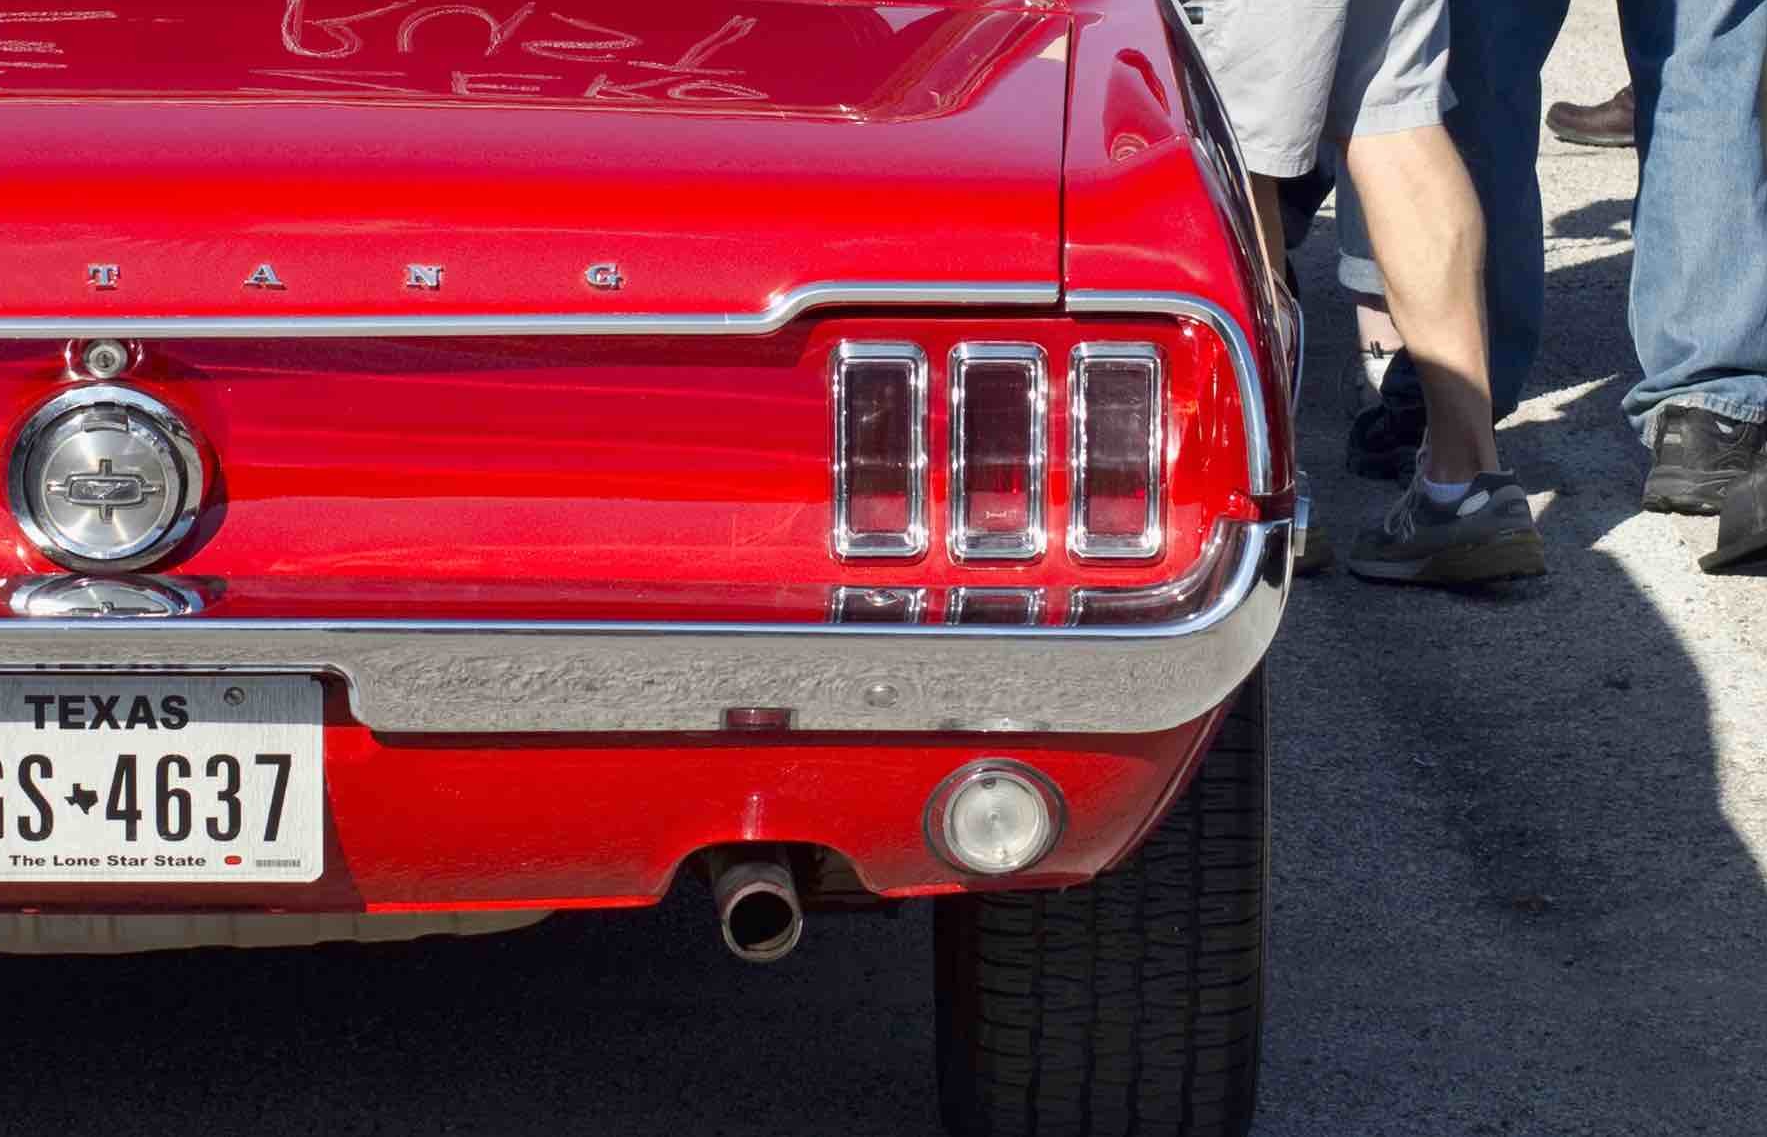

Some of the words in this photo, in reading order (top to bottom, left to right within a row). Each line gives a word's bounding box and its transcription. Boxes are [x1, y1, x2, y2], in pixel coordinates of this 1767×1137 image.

[25, 694, 189, 730] TEXAS
[105, 753, 292, 842] 4637
[9, 854, 46, 867] The
[53, 854, 103, 867] Lone
[107, 854, 148, 867] Star
[154, 854, 207, 867] State
